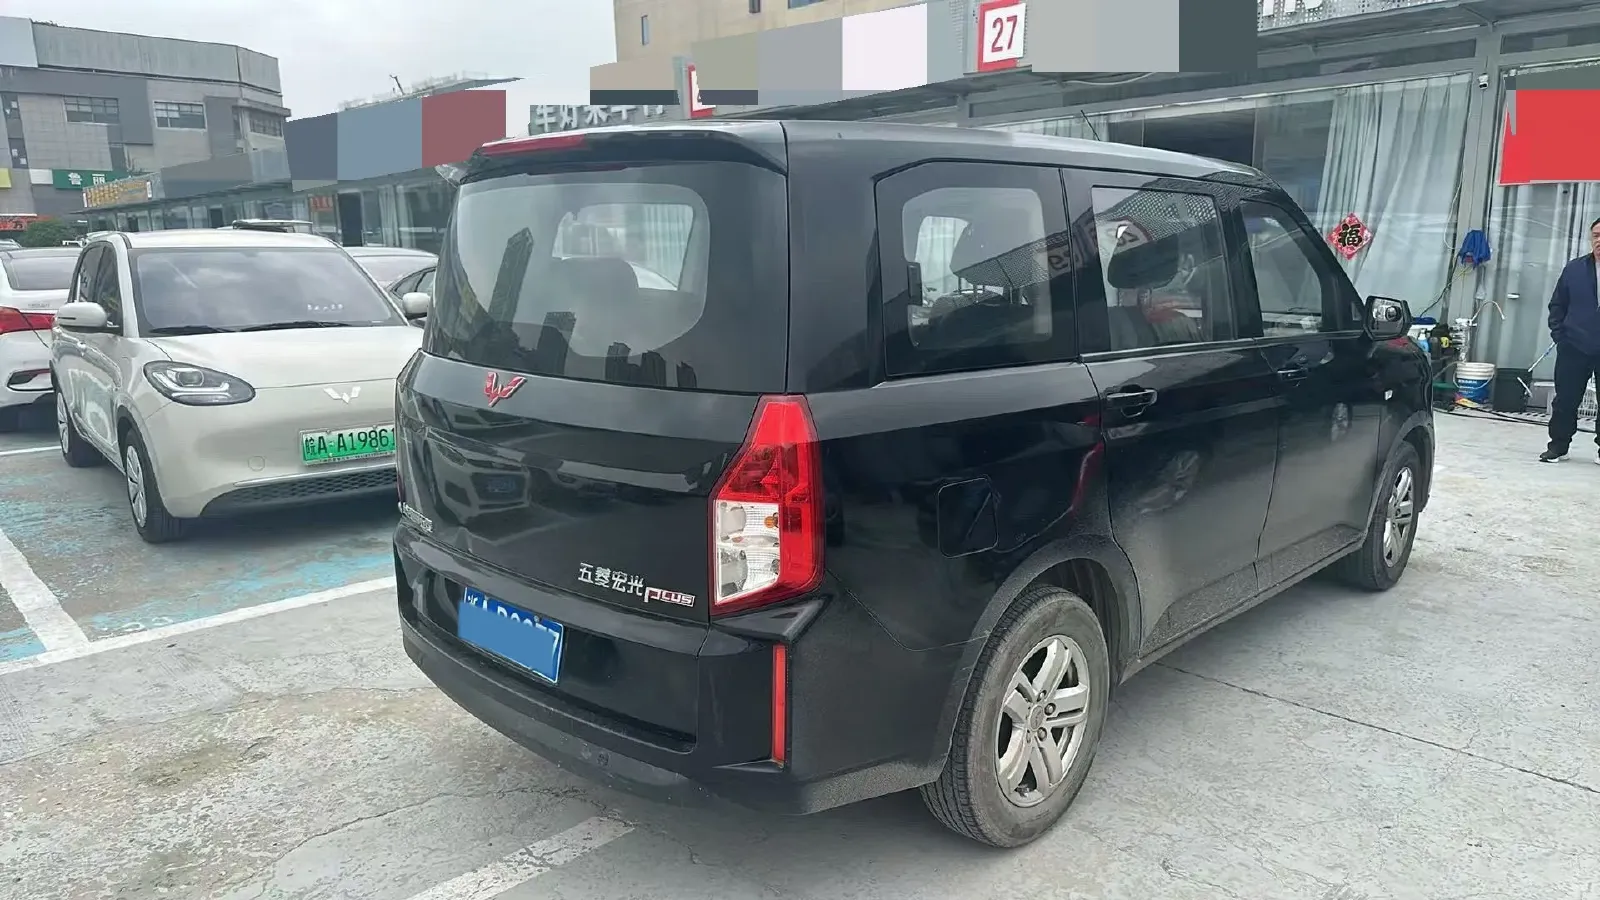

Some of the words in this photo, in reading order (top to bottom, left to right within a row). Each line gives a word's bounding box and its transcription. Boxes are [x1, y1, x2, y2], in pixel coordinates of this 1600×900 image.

[991, 15, 1018, 52] 27
[1338, 223, 1362, 247] 福
[578, 562, 644, 596] 五菱宏光
